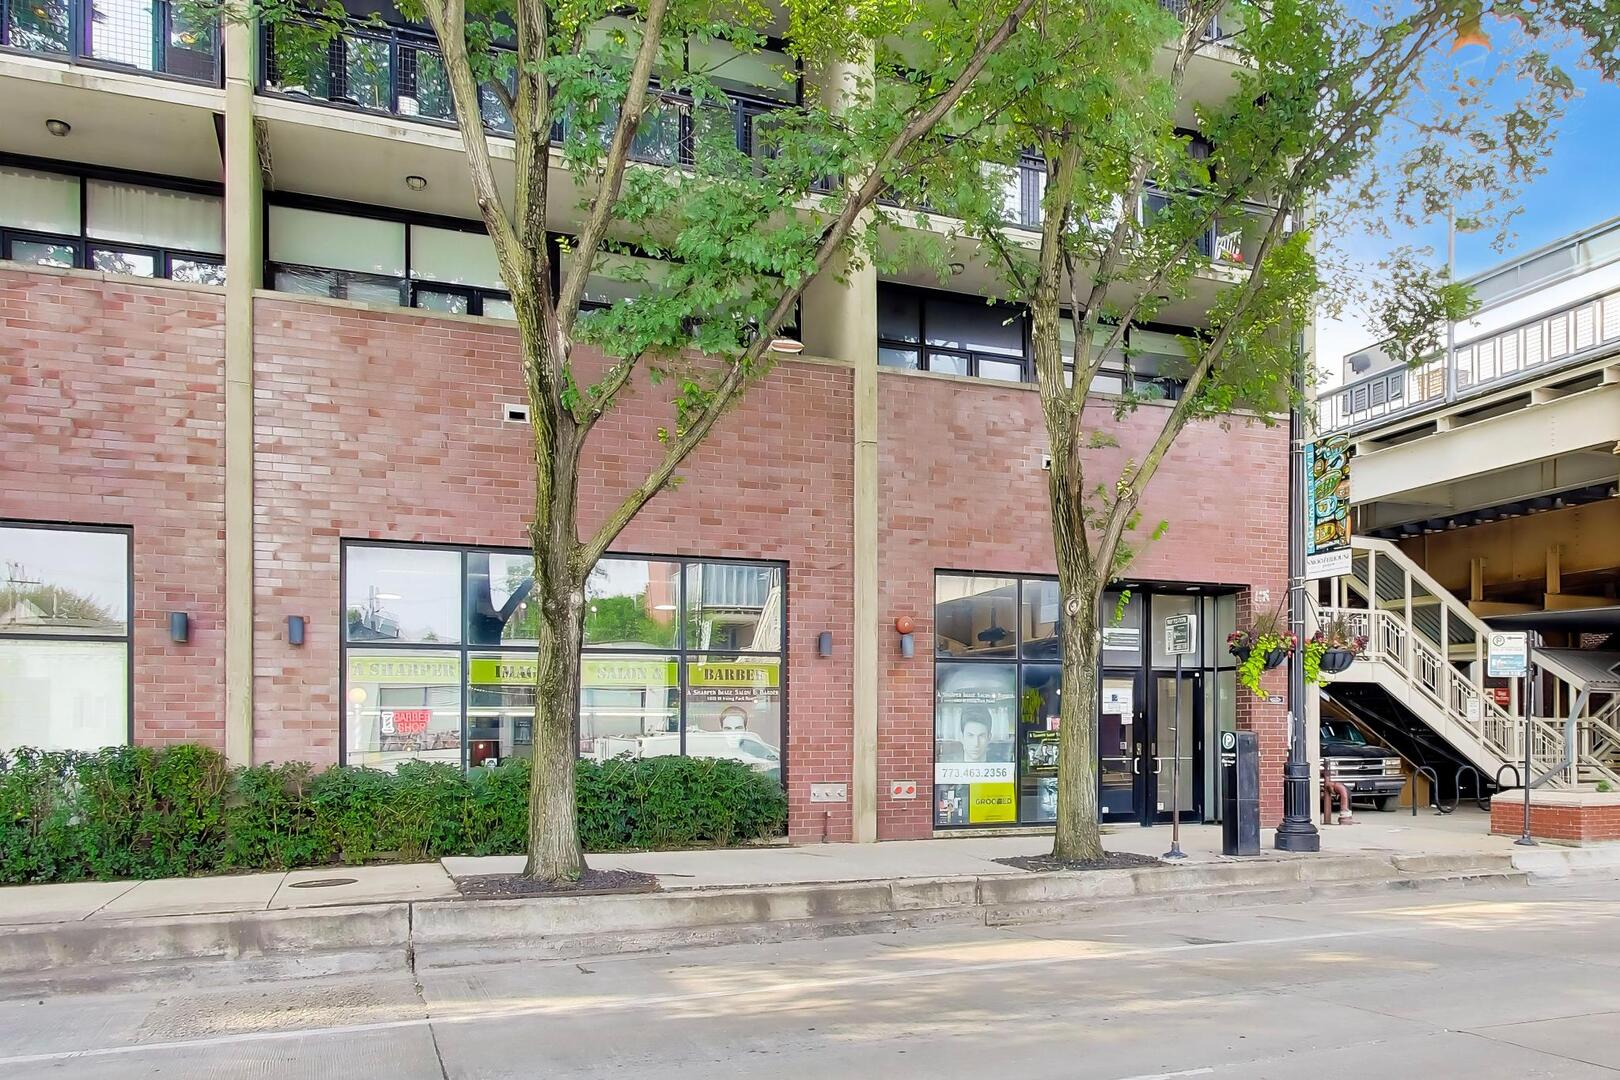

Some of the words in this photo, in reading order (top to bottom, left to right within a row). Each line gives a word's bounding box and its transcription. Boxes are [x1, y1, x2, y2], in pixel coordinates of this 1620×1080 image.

[495, 665, 538, 679] IMAG
[704, 668, 763, 681] BARBER
[394, 710, 431, 723] BARBER
[396, 721, 428, 734] SHOP
[942, 768, 1007, 778] 773.463.2356
